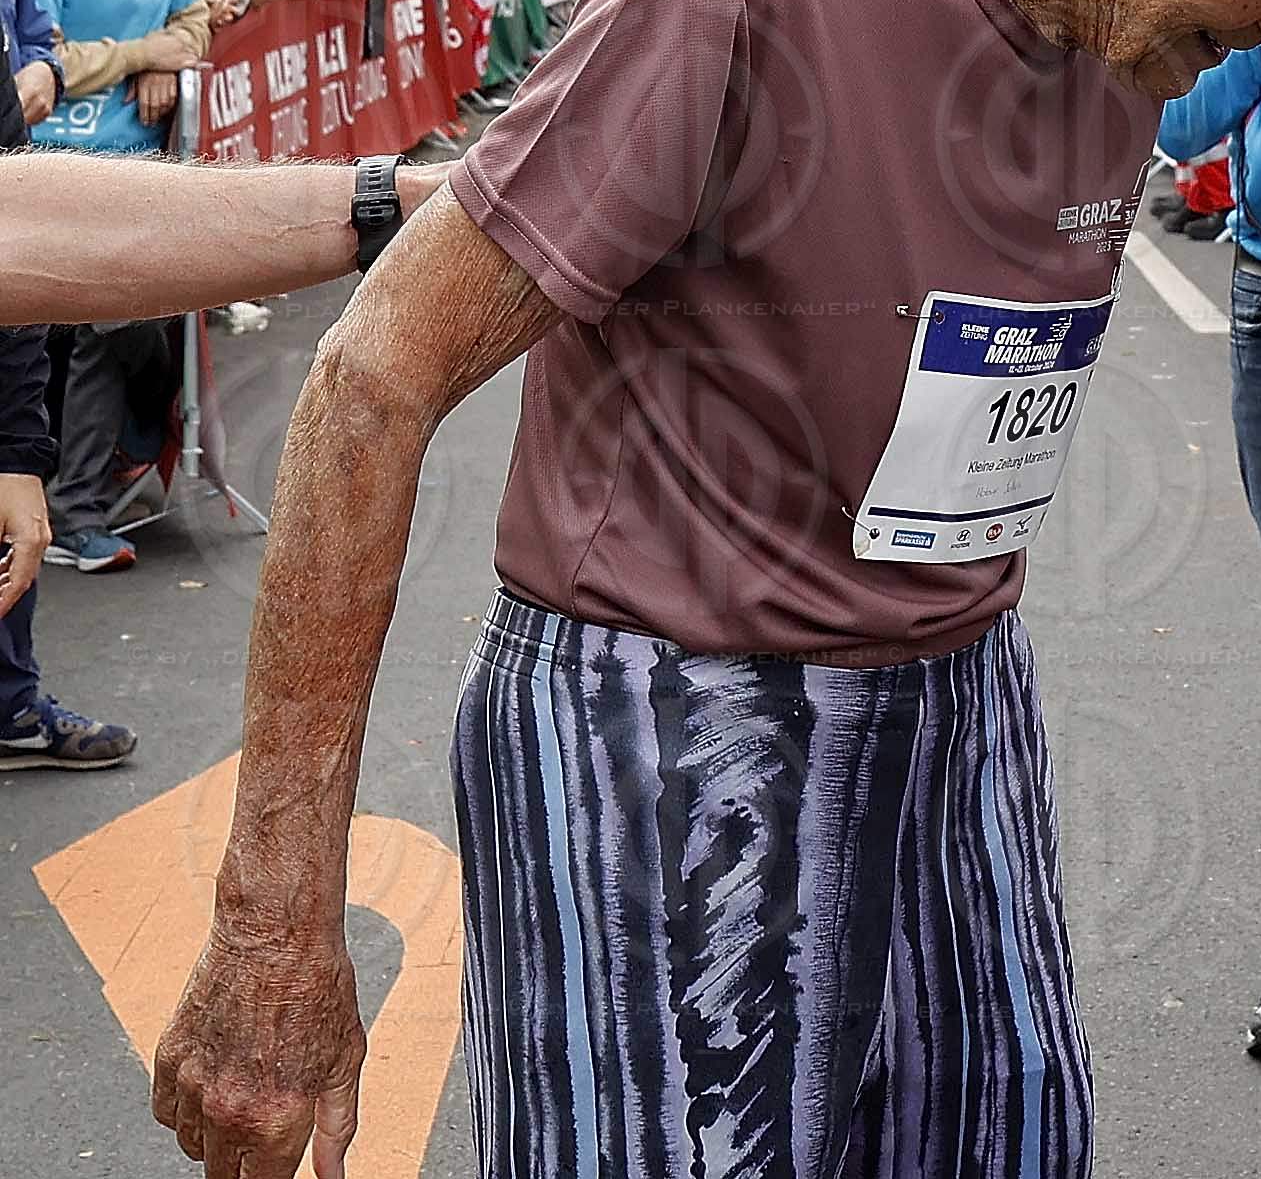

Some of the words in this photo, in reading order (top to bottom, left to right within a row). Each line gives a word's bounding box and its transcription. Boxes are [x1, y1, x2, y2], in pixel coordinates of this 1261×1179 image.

[1079, 198, 1122, 228] GRAZ
[993, 326, 1039, 346] GRAZ
[984, 342, 1063, 364] MARATHON
[986, 381, 1078, 445] 1820
[967, 459, 994, 474] Kleine
